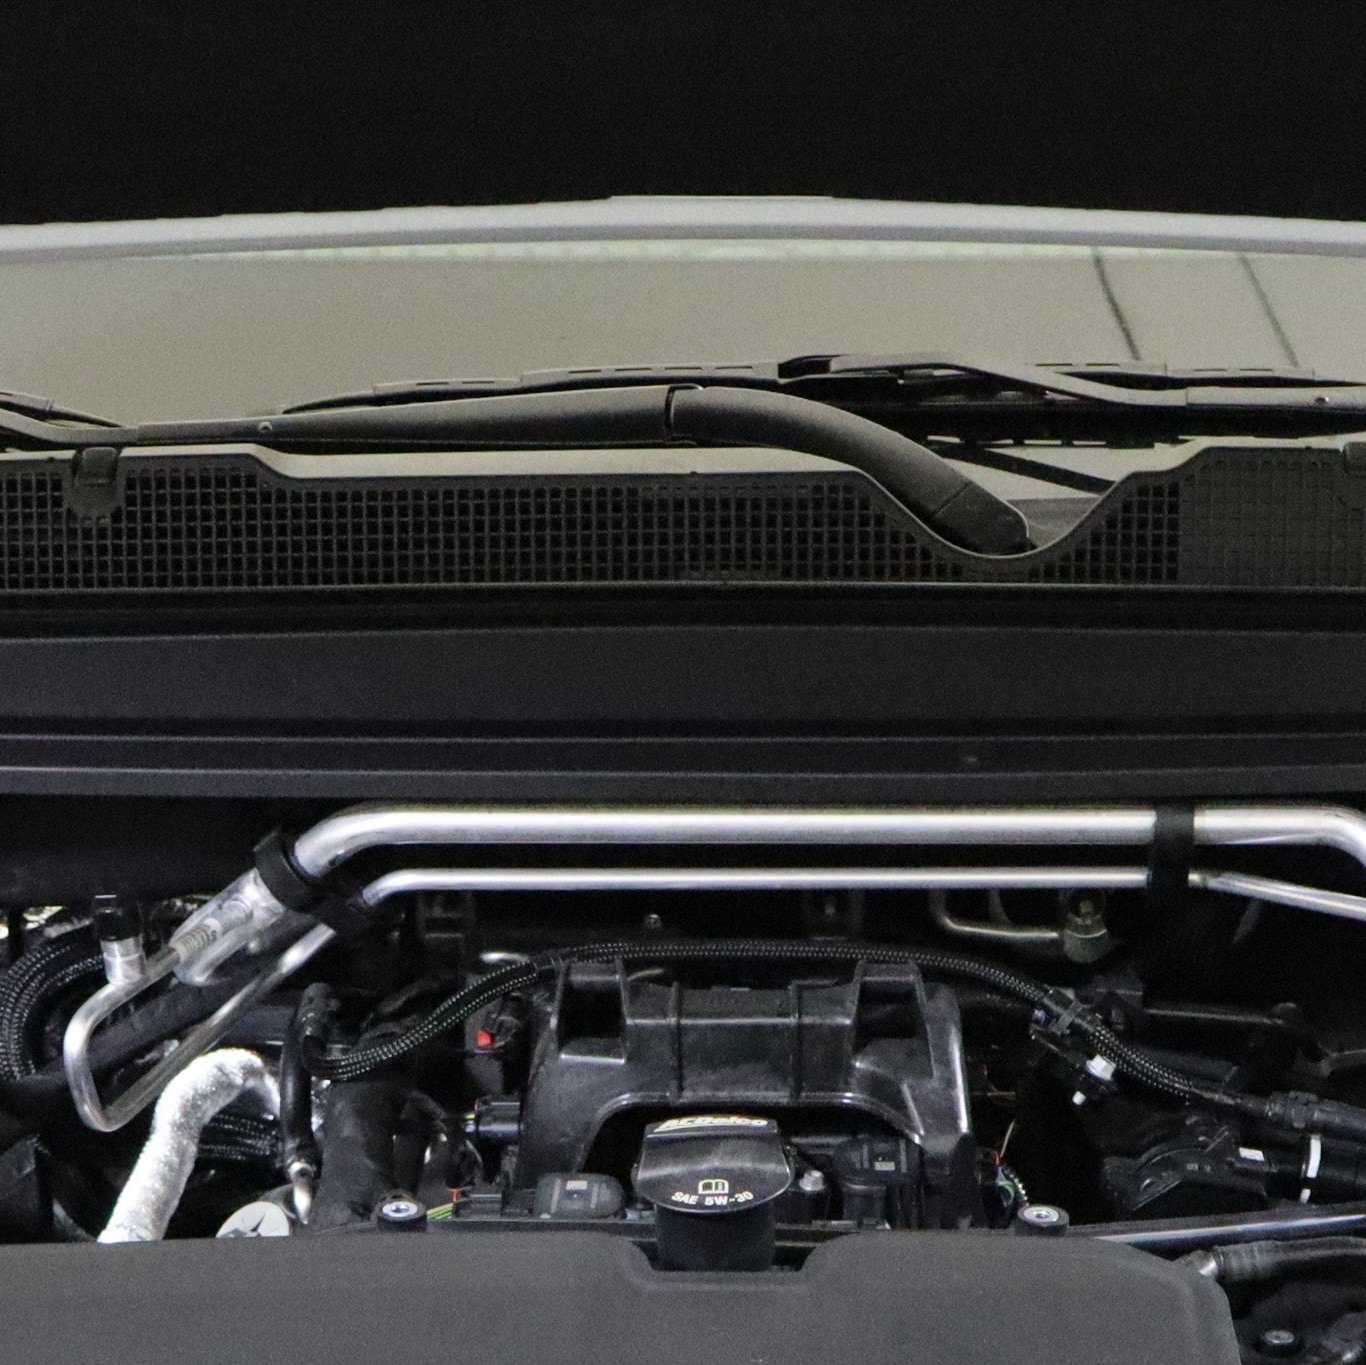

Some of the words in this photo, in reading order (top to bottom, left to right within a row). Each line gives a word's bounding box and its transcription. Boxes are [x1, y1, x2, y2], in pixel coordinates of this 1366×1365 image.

[653, 1116, 768, 1132] ACDelco
[671, 1191, 699, 1205] SAE
[704, 1191, 754, 1206] 5W-30
